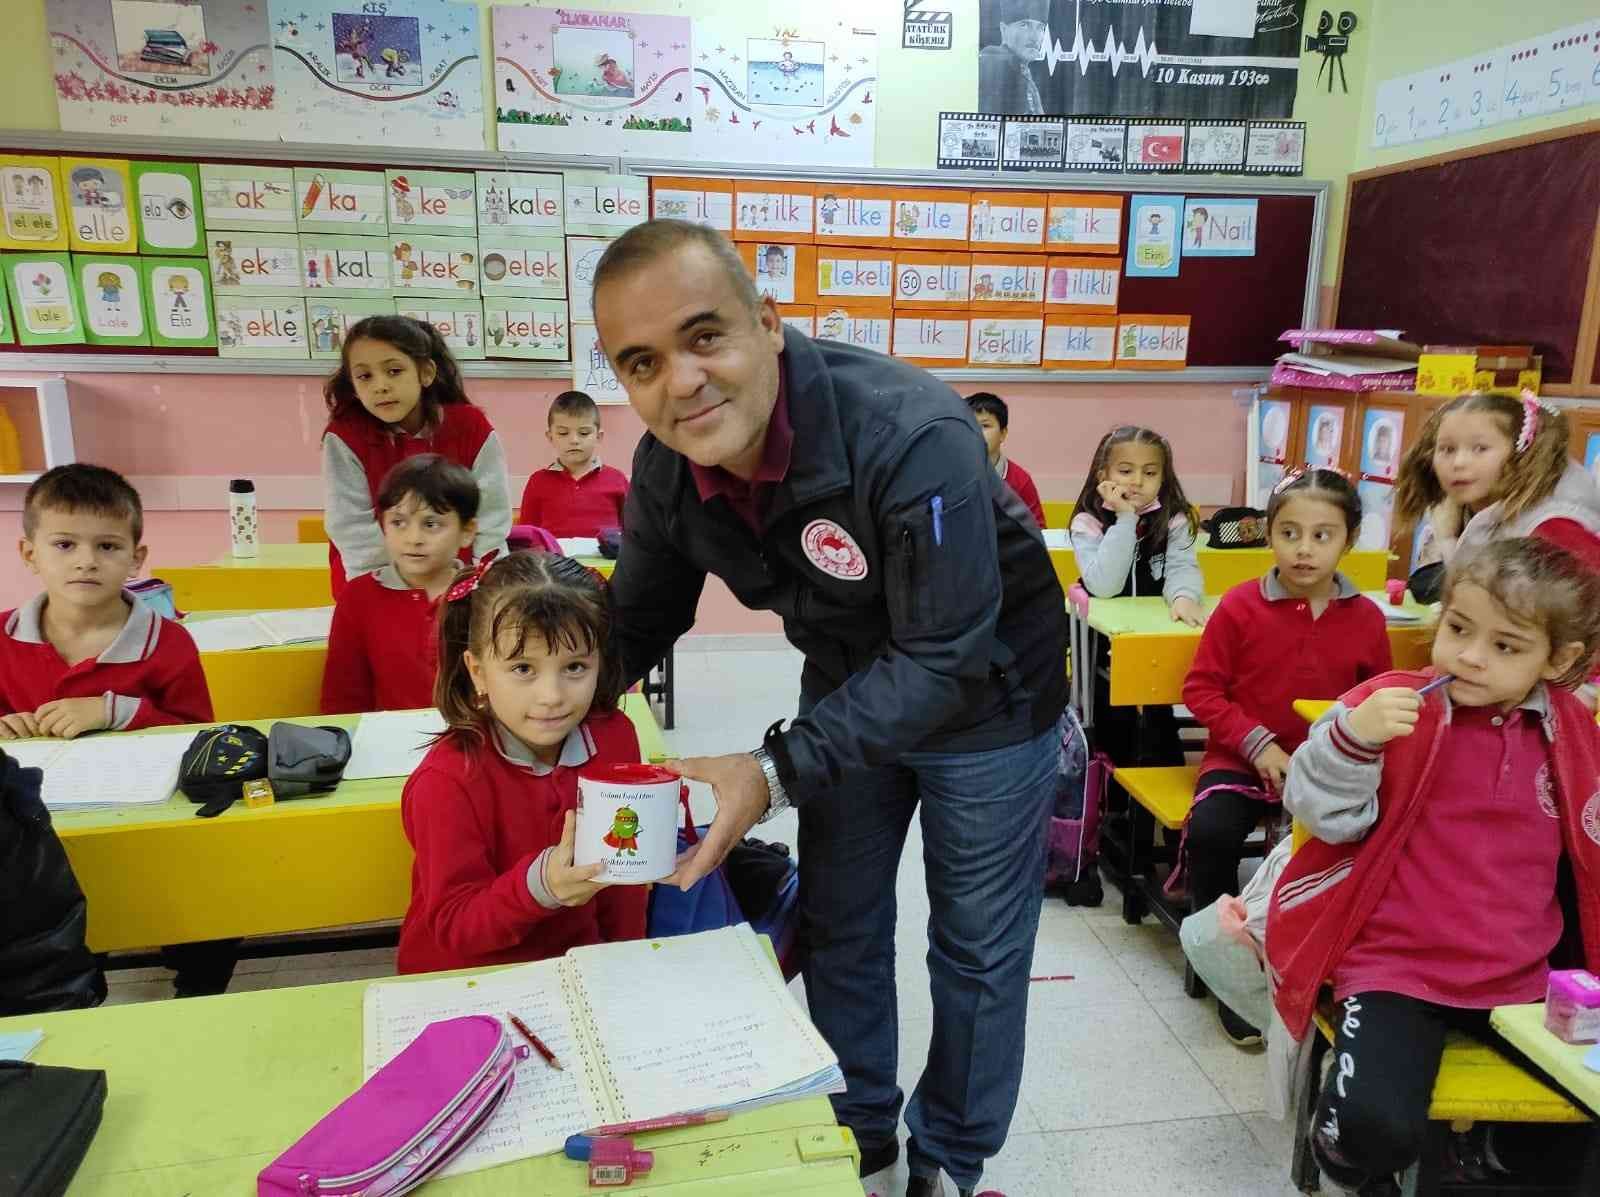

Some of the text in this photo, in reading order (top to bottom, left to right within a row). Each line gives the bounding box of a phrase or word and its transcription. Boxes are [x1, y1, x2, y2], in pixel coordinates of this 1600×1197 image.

[905, 23, 946, 34] ATATÜRK
[1156, 67, 1175, 84] 10
[1177, 69, 1225, 86] Kasım
[1548, 67, 1565, 97] 5
[1470, 90, 1482, 116] 3
[1504, 79, 1521, 107] 4
[1376, 113, 1386, 136] 0
[1438, 98, 1449, 124] 2
[235, 180, 265, 209] ak
[328, 182, 358, 212] ka
[420, 186, 448, 215] ke
[507, 185, 558, 215] kale
[594, 187, 642, 216] leke
[144, 202, 162, 218] ela
[775, 194, 800, 223] ilk
[927, 202, 952, 230] ile
[1000, 207, 1039, 233] aile
[1083, 207, 1102, 233] ik
[79, 214, 125, 241] elle
[1208, 215, 1254, 242] Nail
[240, 247, 269, 276] ek
[336, 248, 373, 278] kal
[420, 250, 459, 279] kek
[508, 249, 559, 278] elek
[833, 260, 891, 287] lekeli
[902, 274, 919, 290] 50
[927, 264, 959, 291] elli
[1001, 265, 1037, 291] ekli
[1072, 268, 1113, 296] ilikli
[246, 308, 299, 337] ekle
[506, 310, 565, 338] kelek
[847, 319, 882, 344] ikili
[919, 319, 945, 345] lik
[976, 321, 1035, 354] keklik
[1065, 327, 1094, 352] kik
[1138, 326, 1186, 352] kekik
